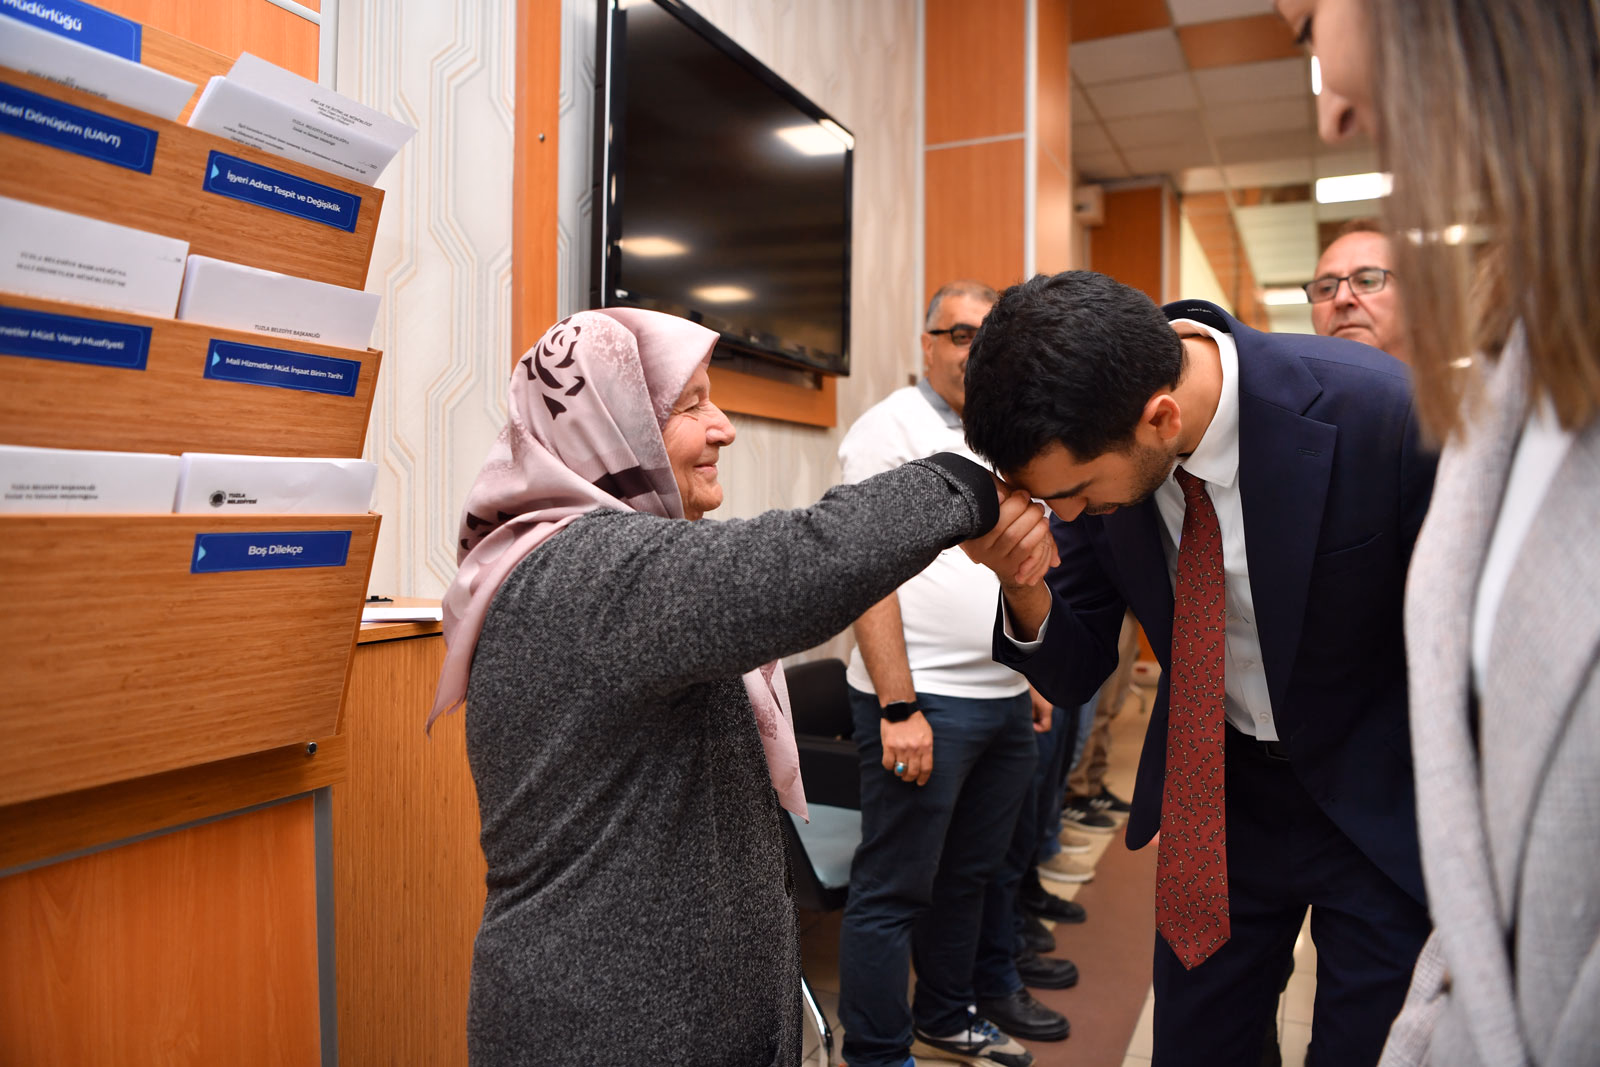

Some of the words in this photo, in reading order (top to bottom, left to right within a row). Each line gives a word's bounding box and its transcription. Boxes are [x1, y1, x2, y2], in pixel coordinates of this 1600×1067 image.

[24, 108, 82, 135] Dönüşüm
[83, 126, 121, 148] (UAVT)
[227, 170, 249, 185] İşyeri
[249, 178, 273, 192] Adres
[273, 185, 297, 200] Tespit
[296, 193, 306, 202] ve
[306, 196, 341, 213] Değişiklik
[57, 332, 82, 346] Vergi
[83, 336, 124, 350] Muafiyeti
[225, 357, 240, 366] Mali
[241, 359, 274, 371] Hizmetler
[274, 364, 290, 373] Müd.
[291, 365, 310, 376] İnşaat
[310, 369, 327, 378] Birim
[327, 371, 344, 380] Tarihi
[248, 545, 268, 557] Boş
[268, 544, 304, 556] Dilekçe
